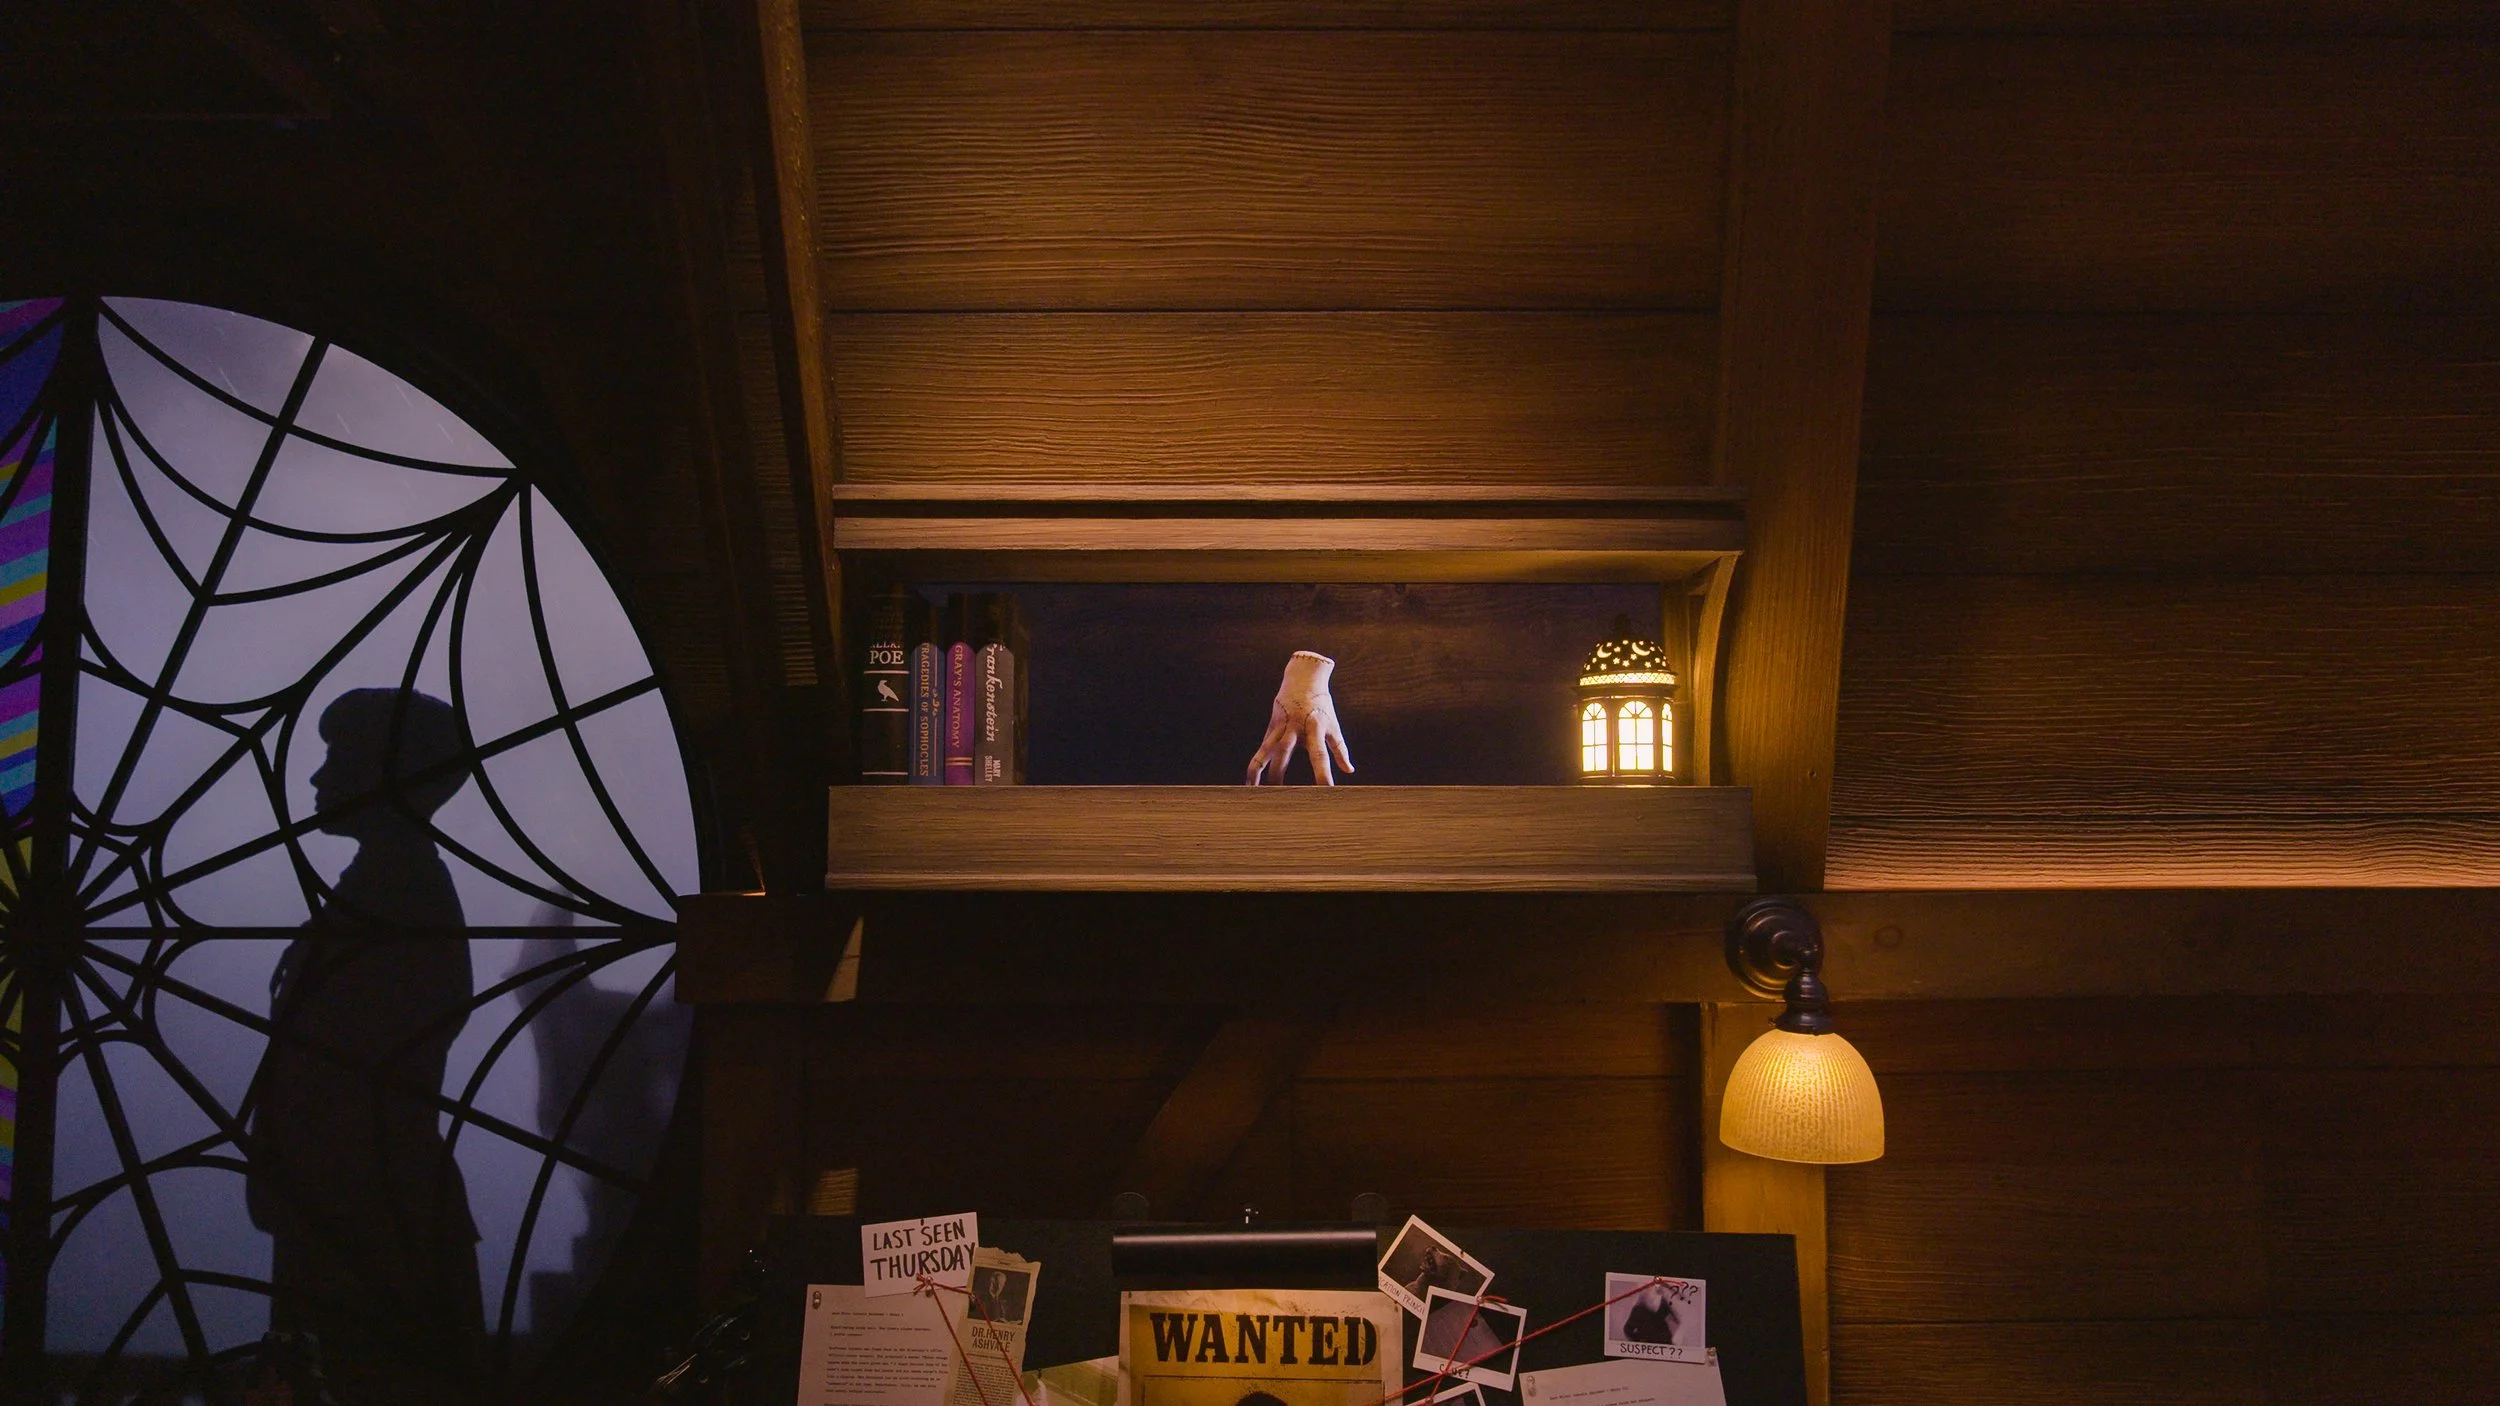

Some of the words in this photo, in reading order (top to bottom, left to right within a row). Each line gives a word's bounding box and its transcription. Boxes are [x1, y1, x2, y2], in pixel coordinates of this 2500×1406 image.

[869, 650, 905, 665] POE
[953, 644, 963, 687] GRAY'S
[921, 701, 929, 712] OF
[951, 689, 962, 748] ANATOMY
[919, 716, 929, 777] SOPHOCLES
[984, 755, 993, 782] SHELLEY
[992, 759, 1001, 778] MARY
[873, 1228, 915, 1251] LAST
[920, 1219, 966, 1246] SEEN
[870, 1242, 976, 1280] THURSDAY
[1379, 1279, 1401, 1297] CATION
[1149, 1312, 1377, 1366] WANTED
